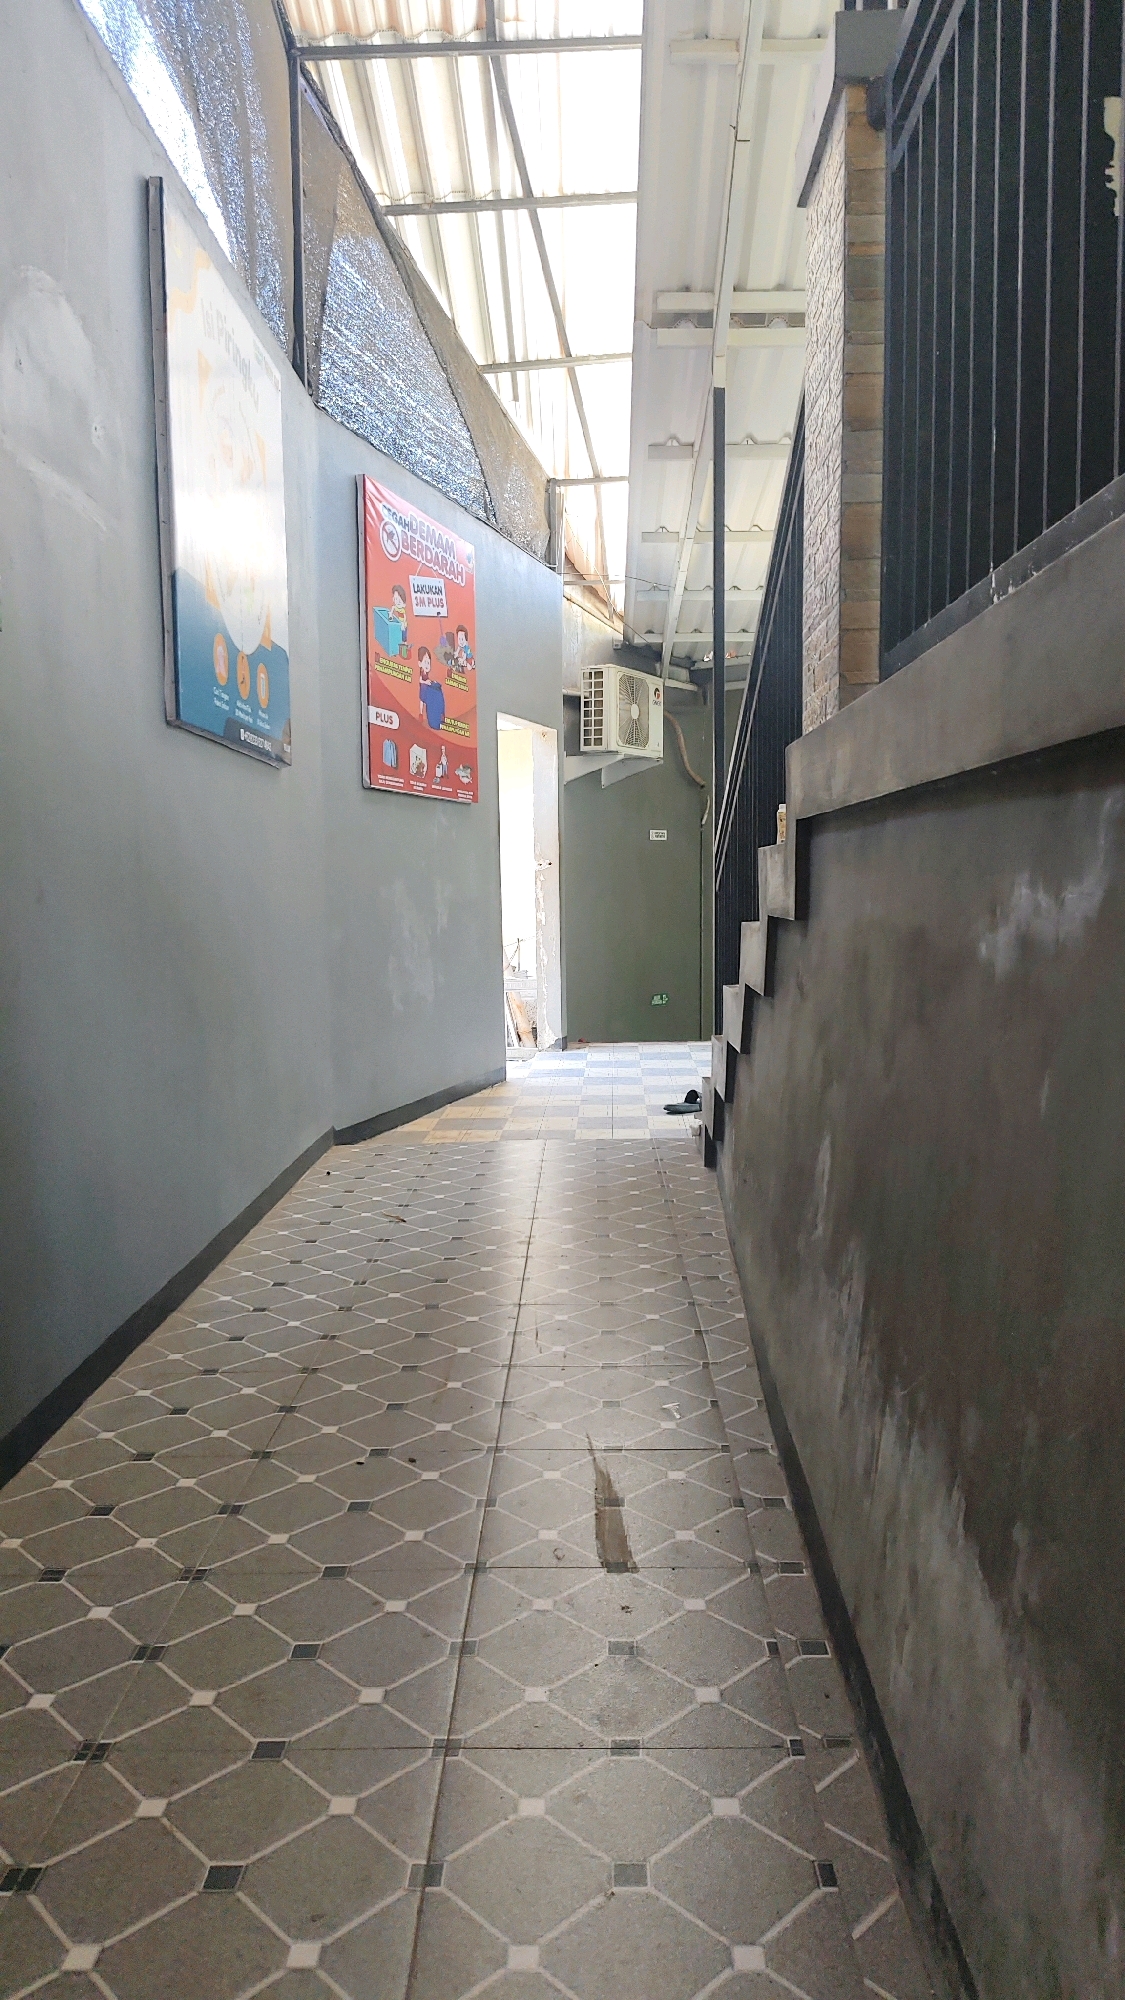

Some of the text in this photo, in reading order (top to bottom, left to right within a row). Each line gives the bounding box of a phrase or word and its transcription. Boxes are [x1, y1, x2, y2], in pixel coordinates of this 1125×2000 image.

[201, 298, 259, 413] Isi Piringku
[409, 514, 455, 558] DEMAM
[401, 529, 465, 584] BERDARAH
[412, 583, 443, 595] LAKUKAN
[415, 597, 444, 609] 3M PLUS
[375, 711, 394, 725] PLUS
